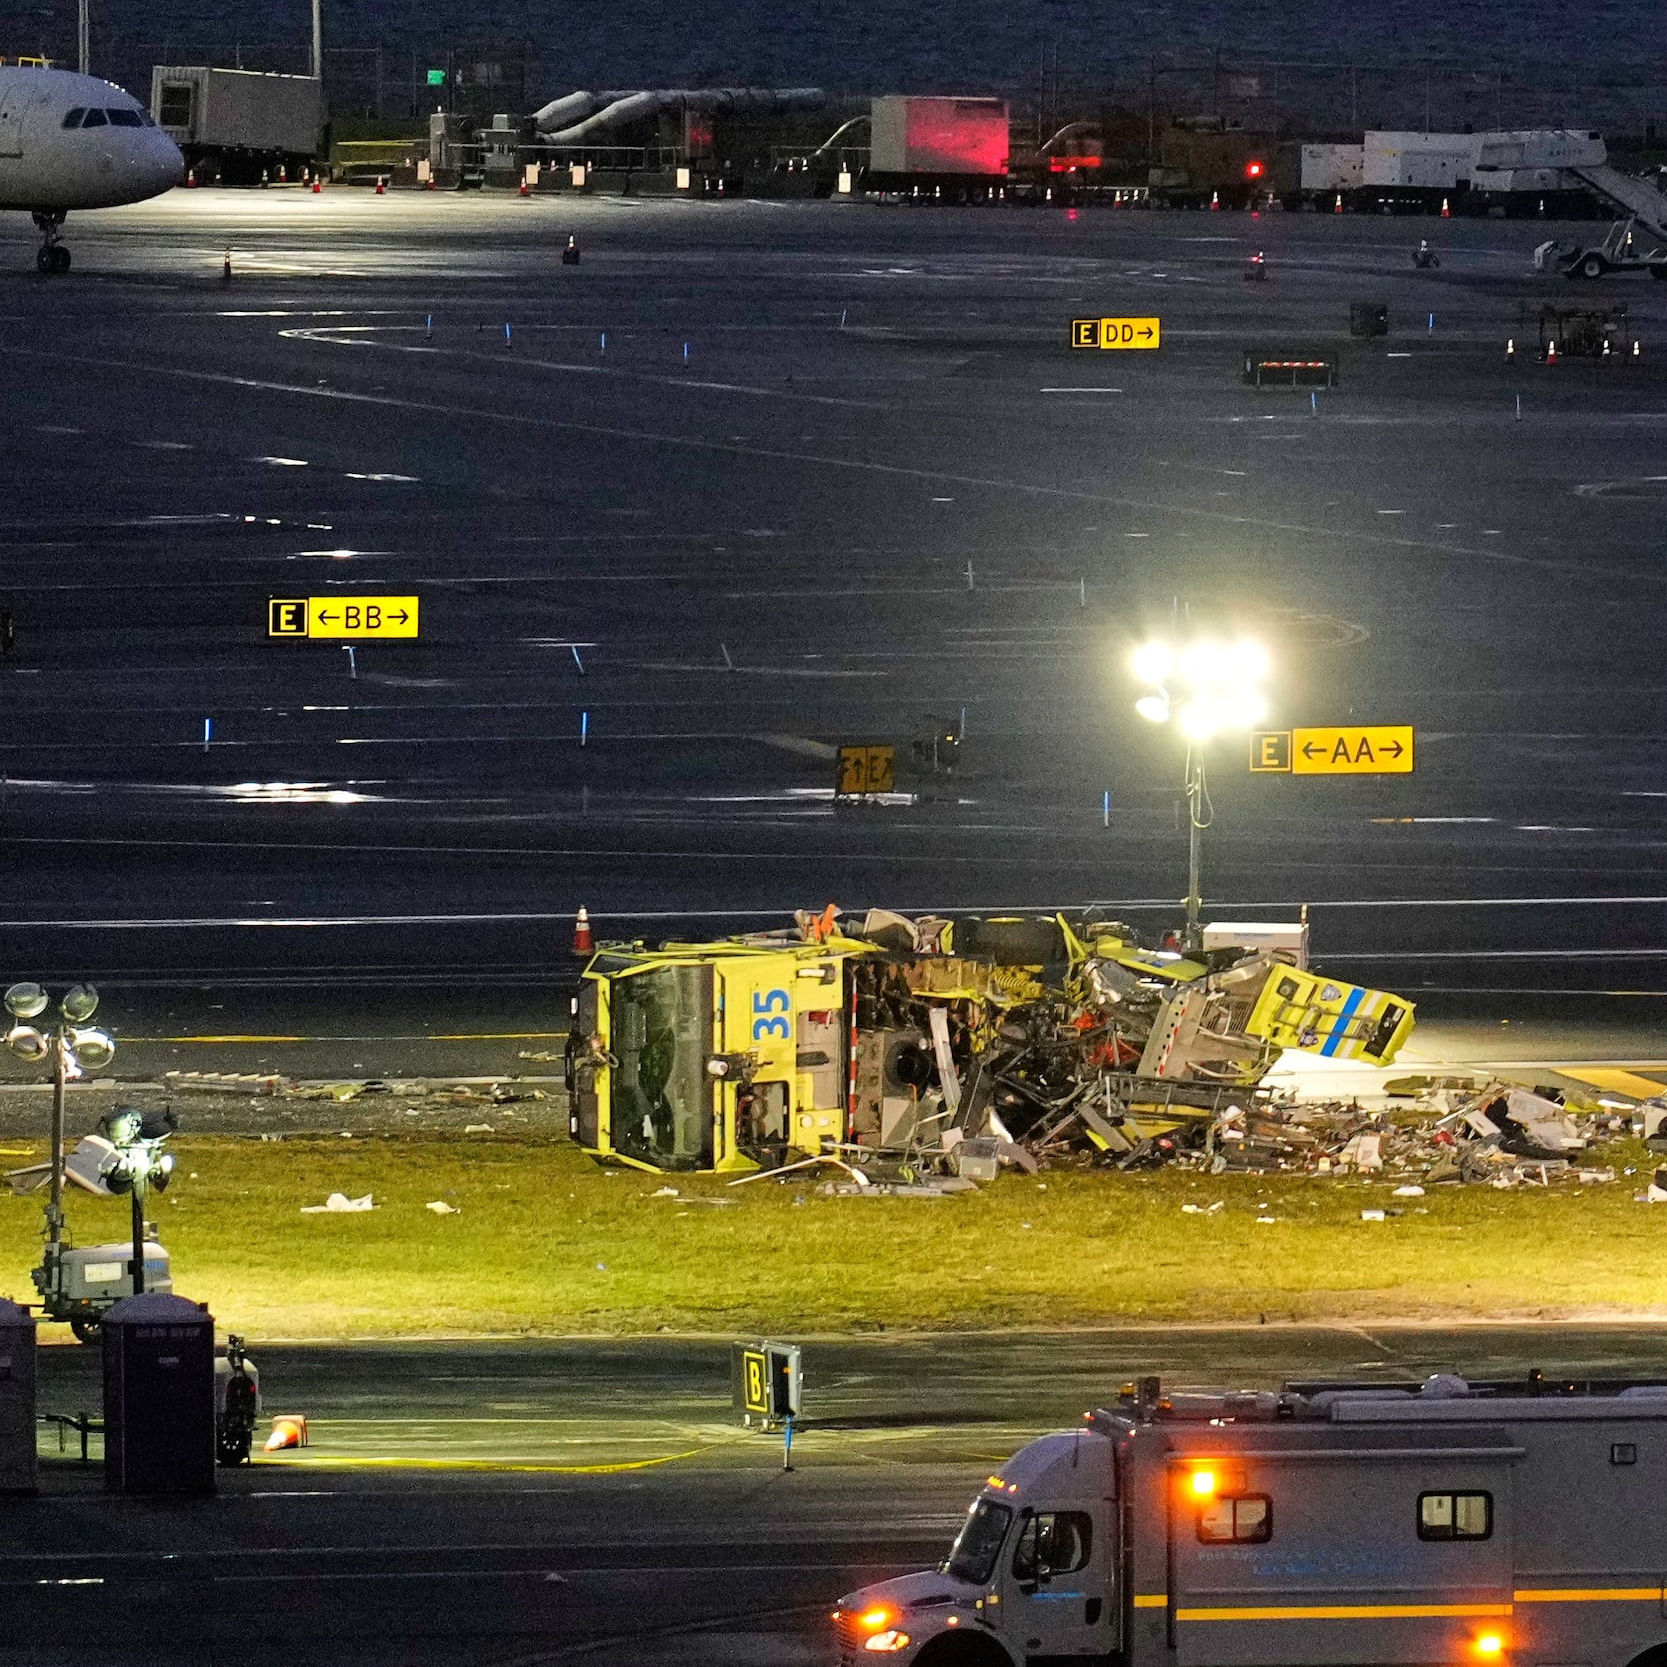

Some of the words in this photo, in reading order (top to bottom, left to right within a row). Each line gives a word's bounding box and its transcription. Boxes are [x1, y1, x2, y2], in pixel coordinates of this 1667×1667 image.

[1080, 323, 1093, 344] E
[1106, 323, 1133, 343] DD
[280, 604, 296, 631] E
[345, 606, 382, 629] BB
[1261, 737, 1279, 765] E
[1331, 736, 1375, 764] AA
[869, 755, 879, 783] E
[753, 989, 790, 1040] 35
[749, 1361, 762, 1402] B
